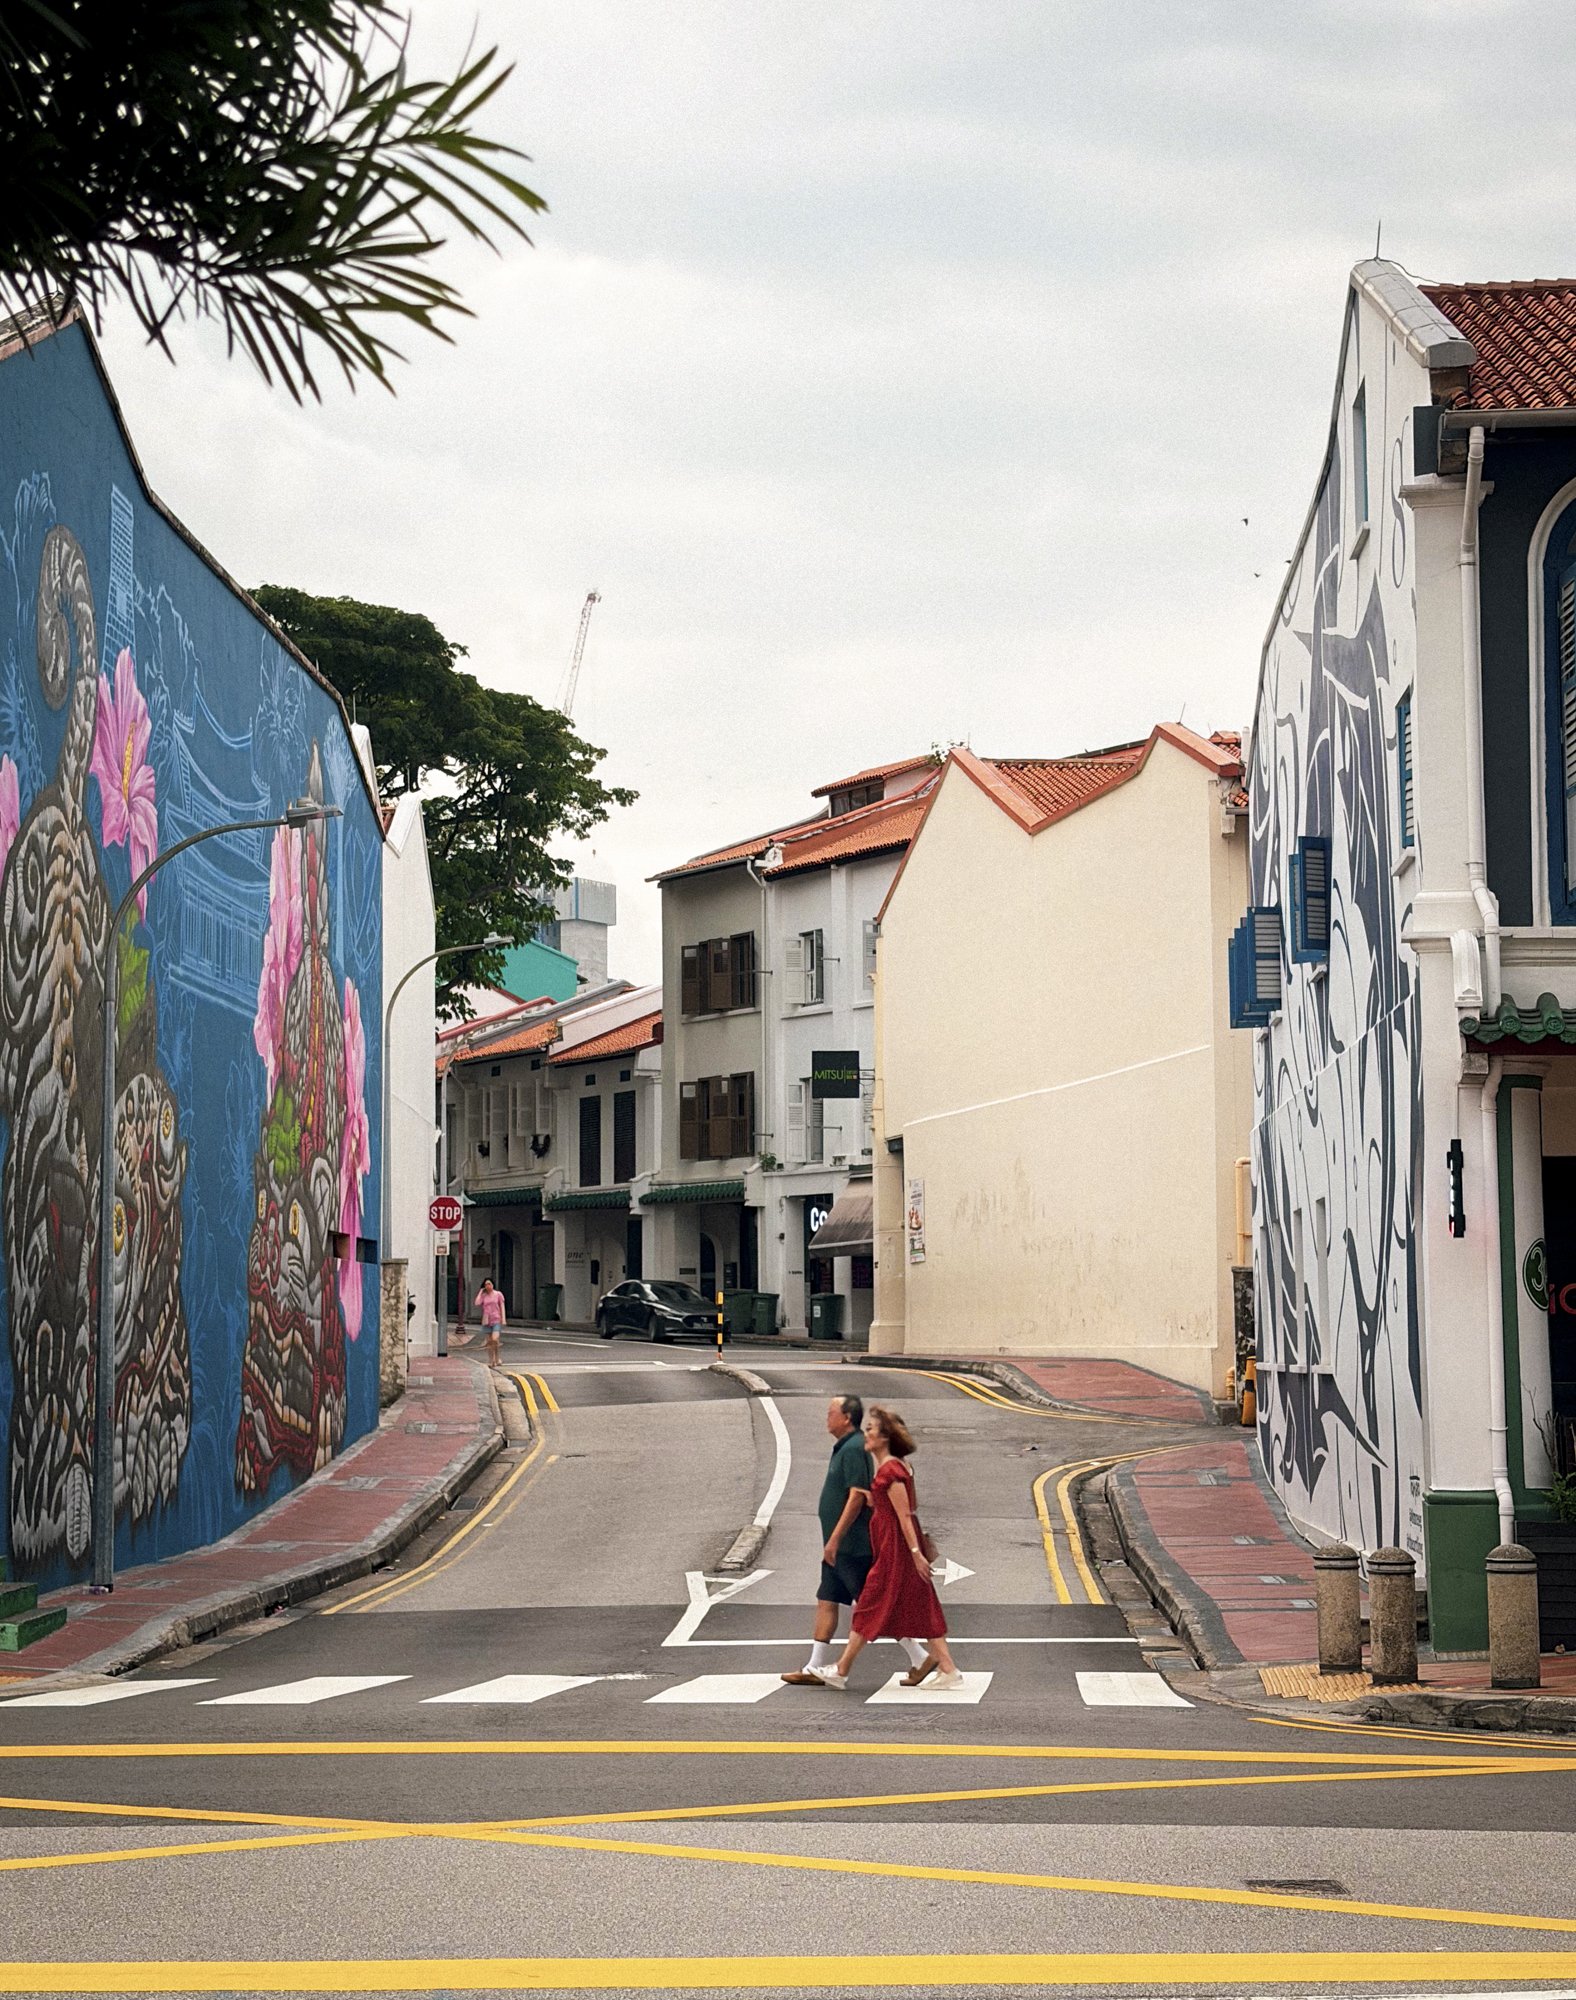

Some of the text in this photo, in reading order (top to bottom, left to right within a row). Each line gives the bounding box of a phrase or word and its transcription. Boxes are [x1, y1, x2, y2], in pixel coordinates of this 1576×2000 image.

[814, 1069, 844, 1080] MITSU
[430, 1206, 461, 1220] STOP
[477, 1238, 486, 1251] 2
